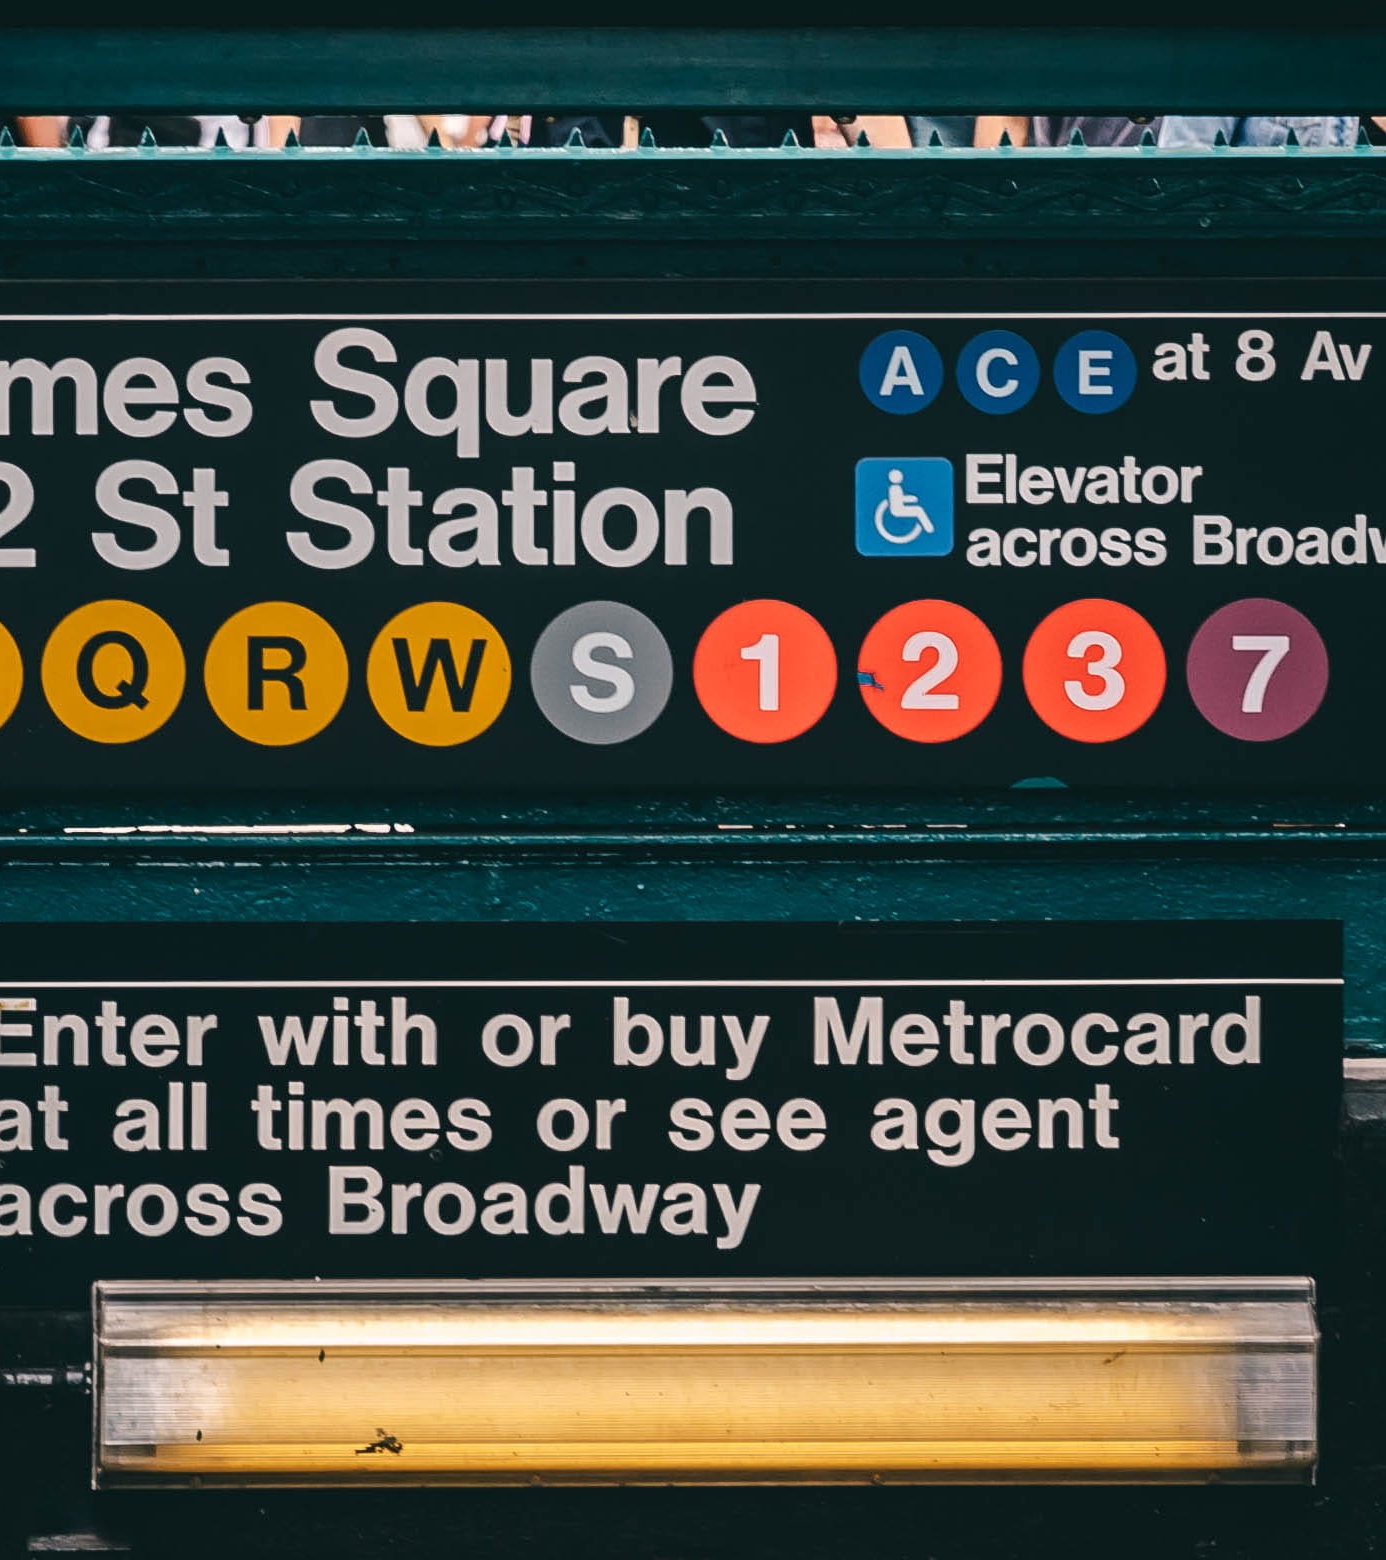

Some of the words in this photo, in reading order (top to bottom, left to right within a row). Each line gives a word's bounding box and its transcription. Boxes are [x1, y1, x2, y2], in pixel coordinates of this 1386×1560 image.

[310, 328, 756, 458] Square
[880, 346, 924, 395] A
[976, 348, 1018, 397] C
[1079, 350, 1113, 394] E
[1153, 333, 1210, 381] at
[1236, 330, 1276, 381] 8
[1301, 331, 1372, 380] Av
[92, 460, 229, 570] St
[286, 459, 733, 569] Station
[966, 454, 1202, 504] Elevator
[967, 528, 1167, 567] across
[77, 632, 149, 710] Q
[248, 636, 307, 710] R
[392, 638, 487, 712] W
[570, 632, 634, 712] S
[741, 634, 779, 711] 1
[901, 632, 959, 709] 2
[1065, 631, 1125, 710] 3
[1233, 636, 1289, 712] 7
[258, 997, 437, 1065] with
[482, 1014, 570, 1067] or
[614, 997, 770, 1080] buy
[814, 996, 1260, 1066] Metrocard
[113, 1082, 207, 1152] all
[251, 1081, 492, 1151] times
[537, 1099, 626, 1151] or
[669, 1098, 826, 1151] see
[871, 1085, 1119, 1167] agent
[329, 1165, 761, 1249] Broadway
